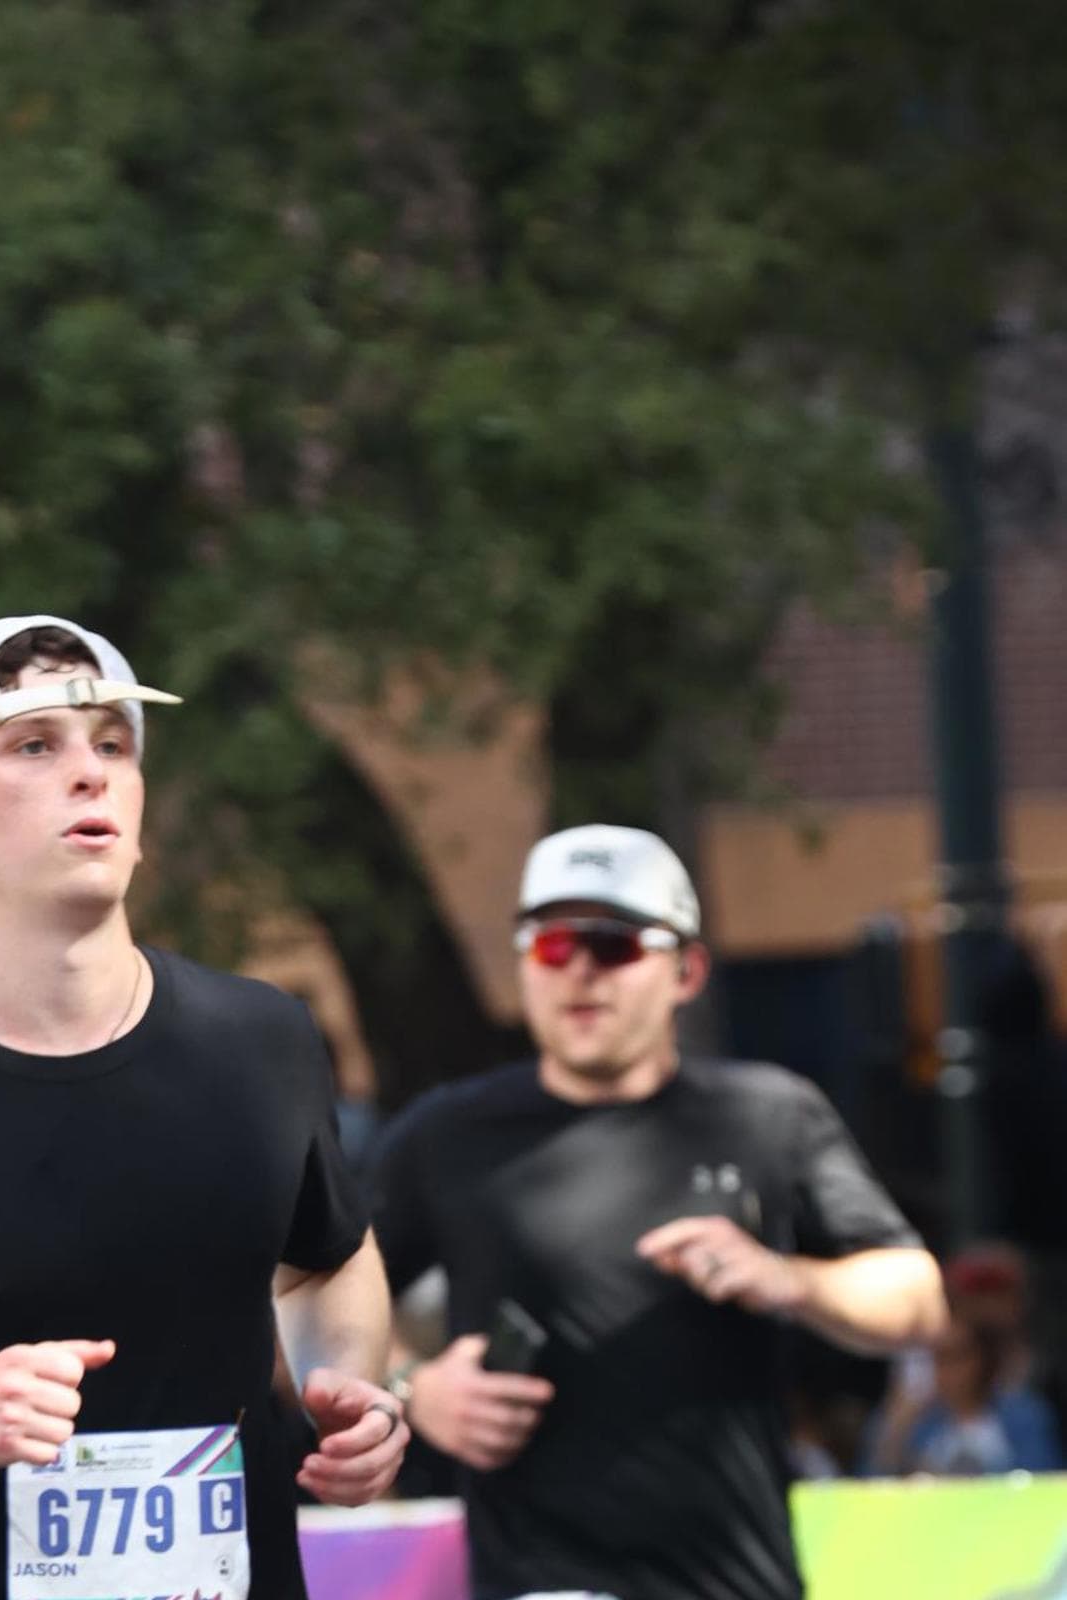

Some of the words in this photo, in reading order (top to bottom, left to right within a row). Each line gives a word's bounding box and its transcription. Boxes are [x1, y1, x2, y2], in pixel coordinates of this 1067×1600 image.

[38, 1485, 174, 1557] 6779
[212, 1482, 233, 1530] C
[13, 1562, 77, 1577] JASON
